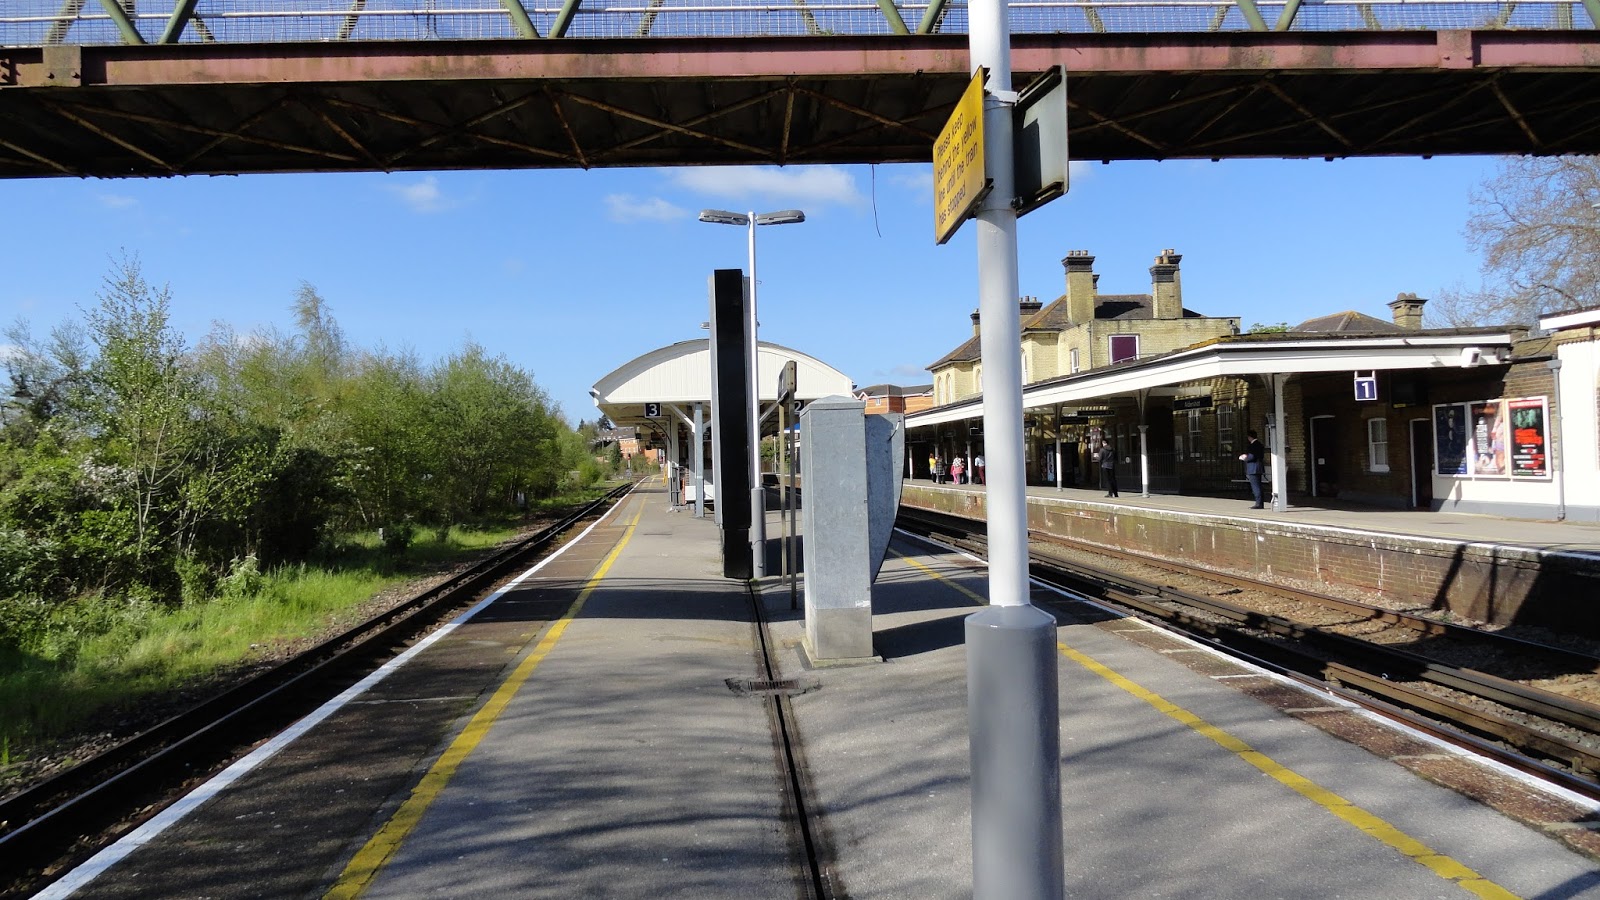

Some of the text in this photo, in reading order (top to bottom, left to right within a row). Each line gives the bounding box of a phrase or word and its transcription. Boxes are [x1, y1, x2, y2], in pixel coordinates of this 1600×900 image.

[937, 112, 963, 159] Please keep
[938, 116, 977, 183] behind the yellow
[938, 141, 978, 206] line until the train
[938, 179, 966, 227] has stopped
[649, 403, 658, 416] 3
[794, 401, 801, 412] 2
[1361, 381, 1370, 398] 1
